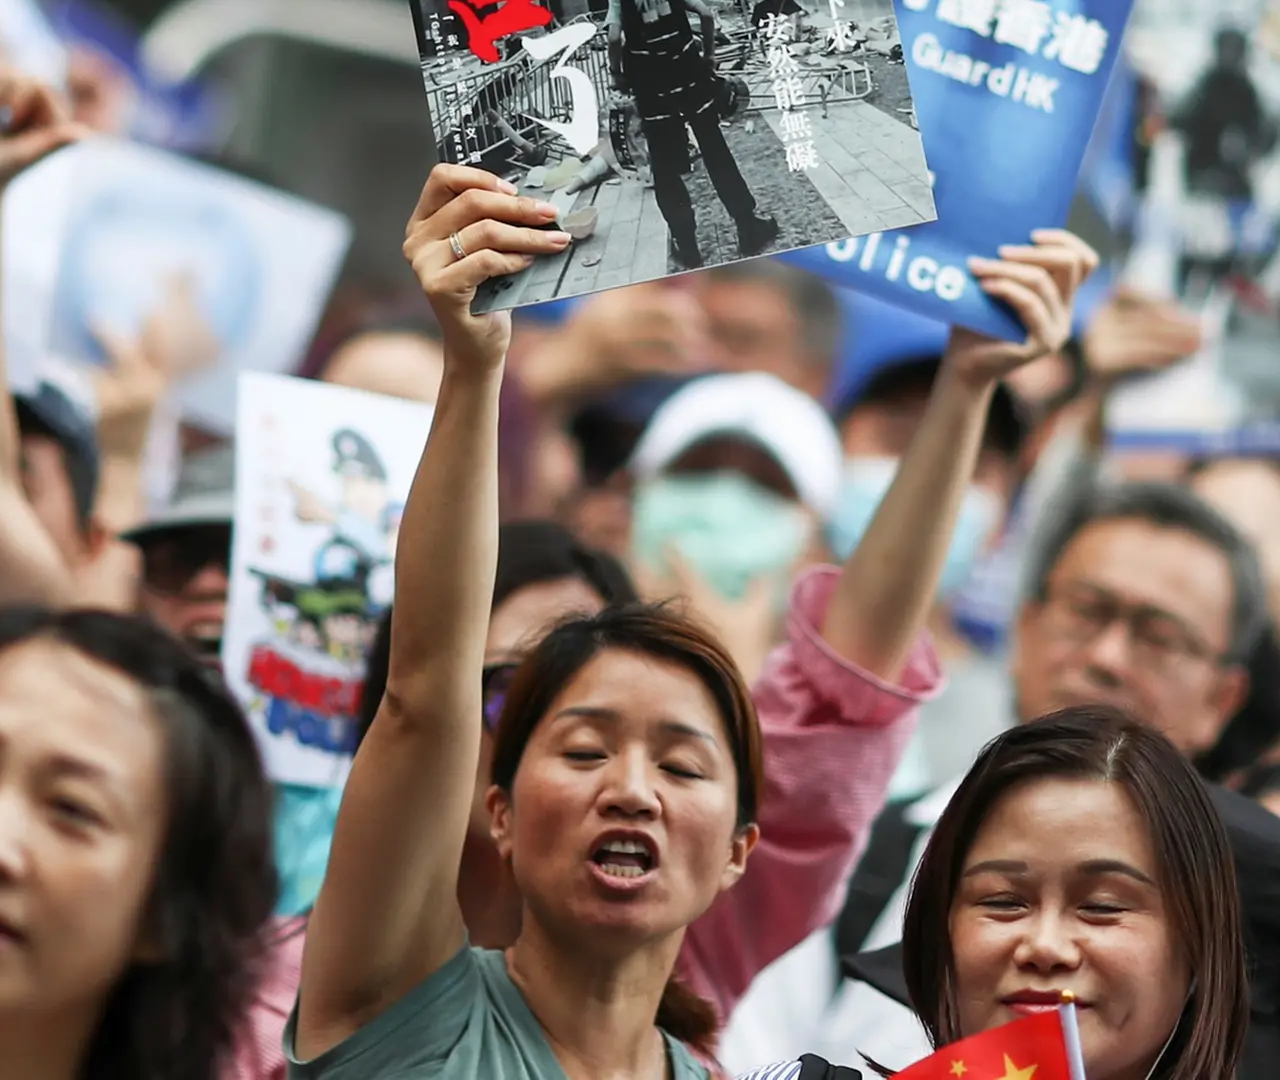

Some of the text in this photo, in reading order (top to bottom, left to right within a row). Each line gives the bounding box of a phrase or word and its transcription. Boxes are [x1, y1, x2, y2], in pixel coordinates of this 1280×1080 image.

[759, 12, 819, 172] 安然能無礙
[825, 231, 966, 301] olice
